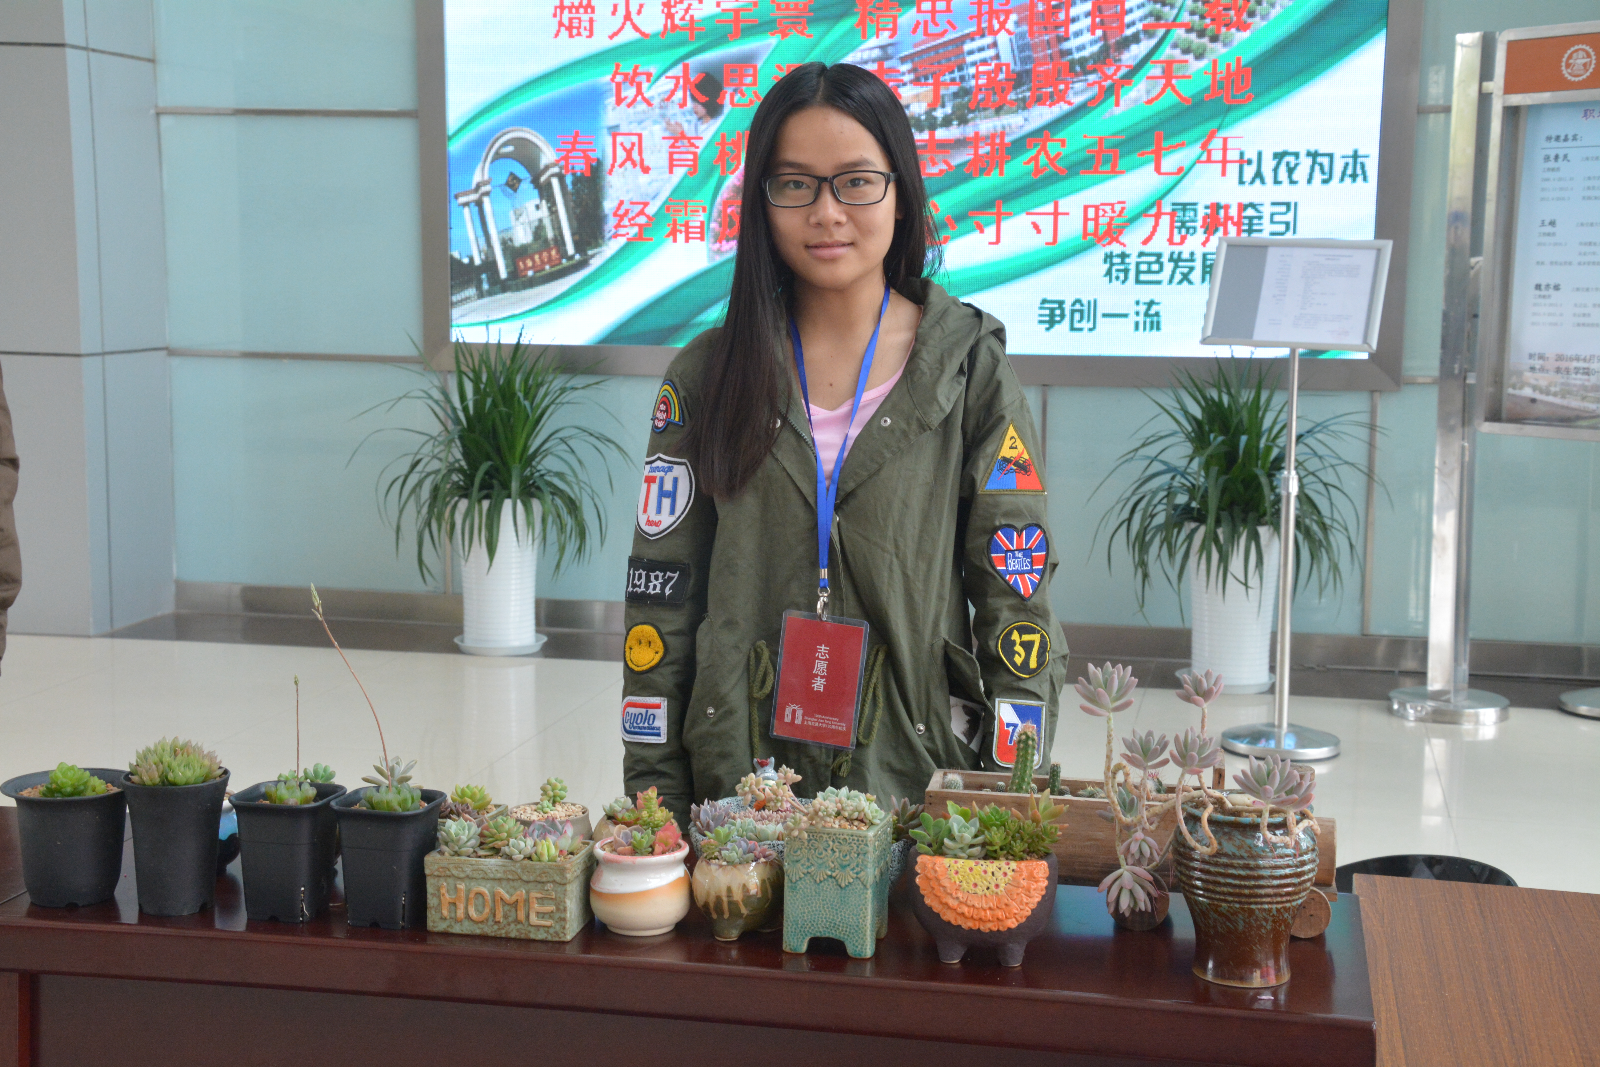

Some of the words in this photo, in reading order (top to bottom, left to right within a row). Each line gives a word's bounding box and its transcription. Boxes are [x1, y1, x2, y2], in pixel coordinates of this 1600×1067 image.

[1581, 108, 1600, 121] 职
[1238, 149, 1368, 186] 以农为本
[1038, 298, 1162, 333] 争创一流
[1009, 436, 1018, 449] 2
[642, 475, 678, 516] TH
[626, 568, 680, 597] 1987
[1010, 629, 1041, 669] 37
[812, 644, 830, 692] 志愿者
[440, 882, 556, 927] HOME
